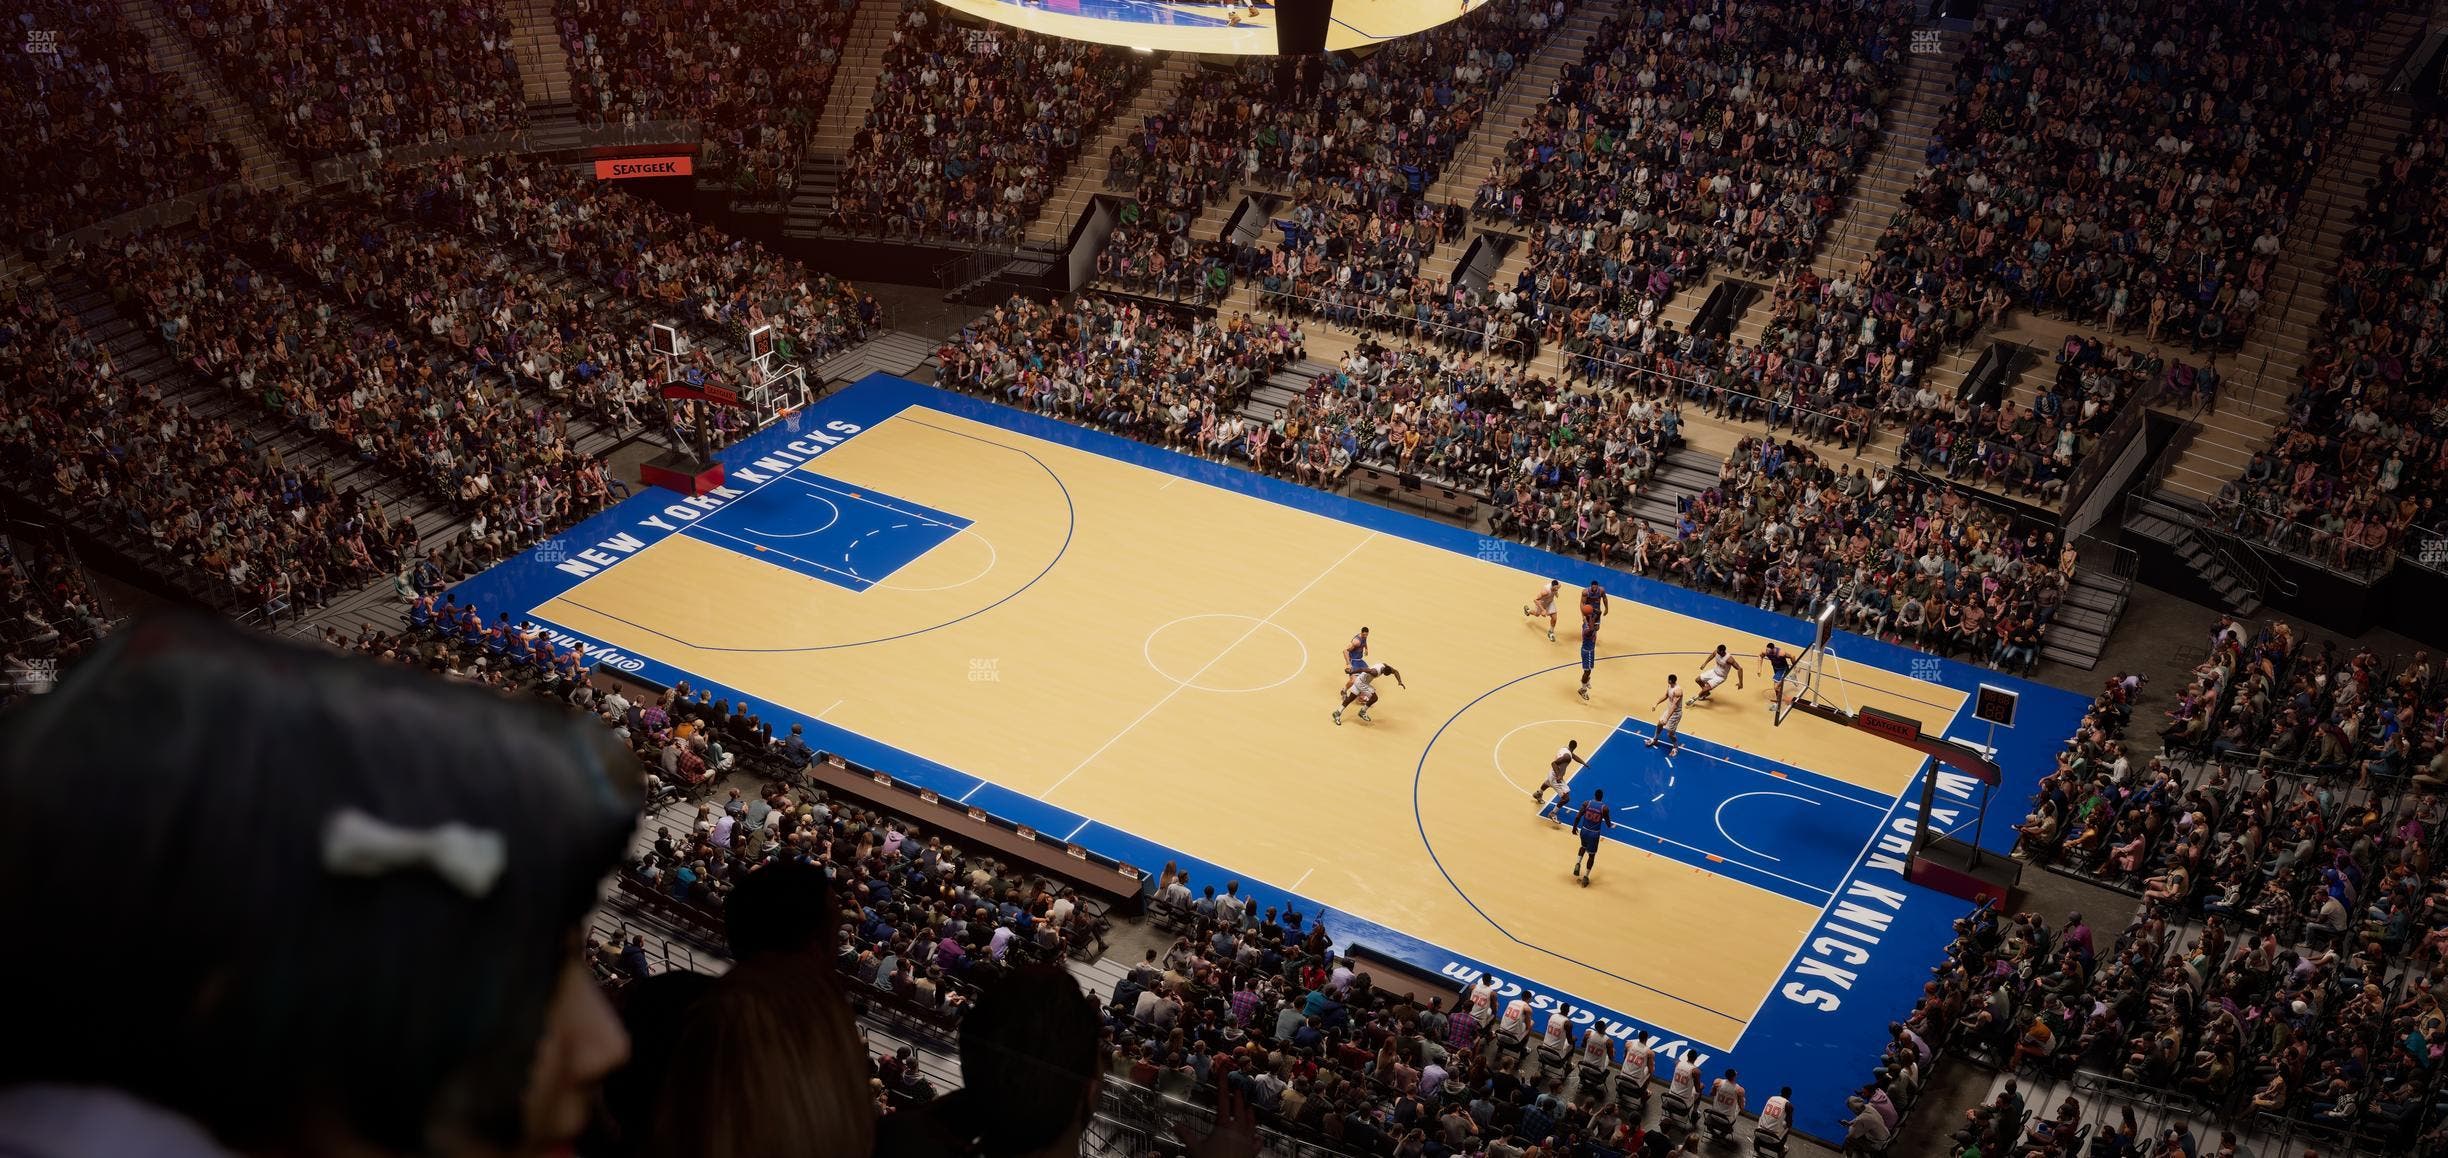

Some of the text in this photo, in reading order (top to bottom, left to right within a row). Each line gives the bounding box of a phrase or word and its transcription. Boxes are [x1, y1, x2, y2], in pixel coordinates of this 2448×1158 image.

[612, 161, 677, 176] SEATGEEK
[555, 420, 861, 578] NEW YORK KNICKS
[1781, 879, 1907, 1012] KNICKS
